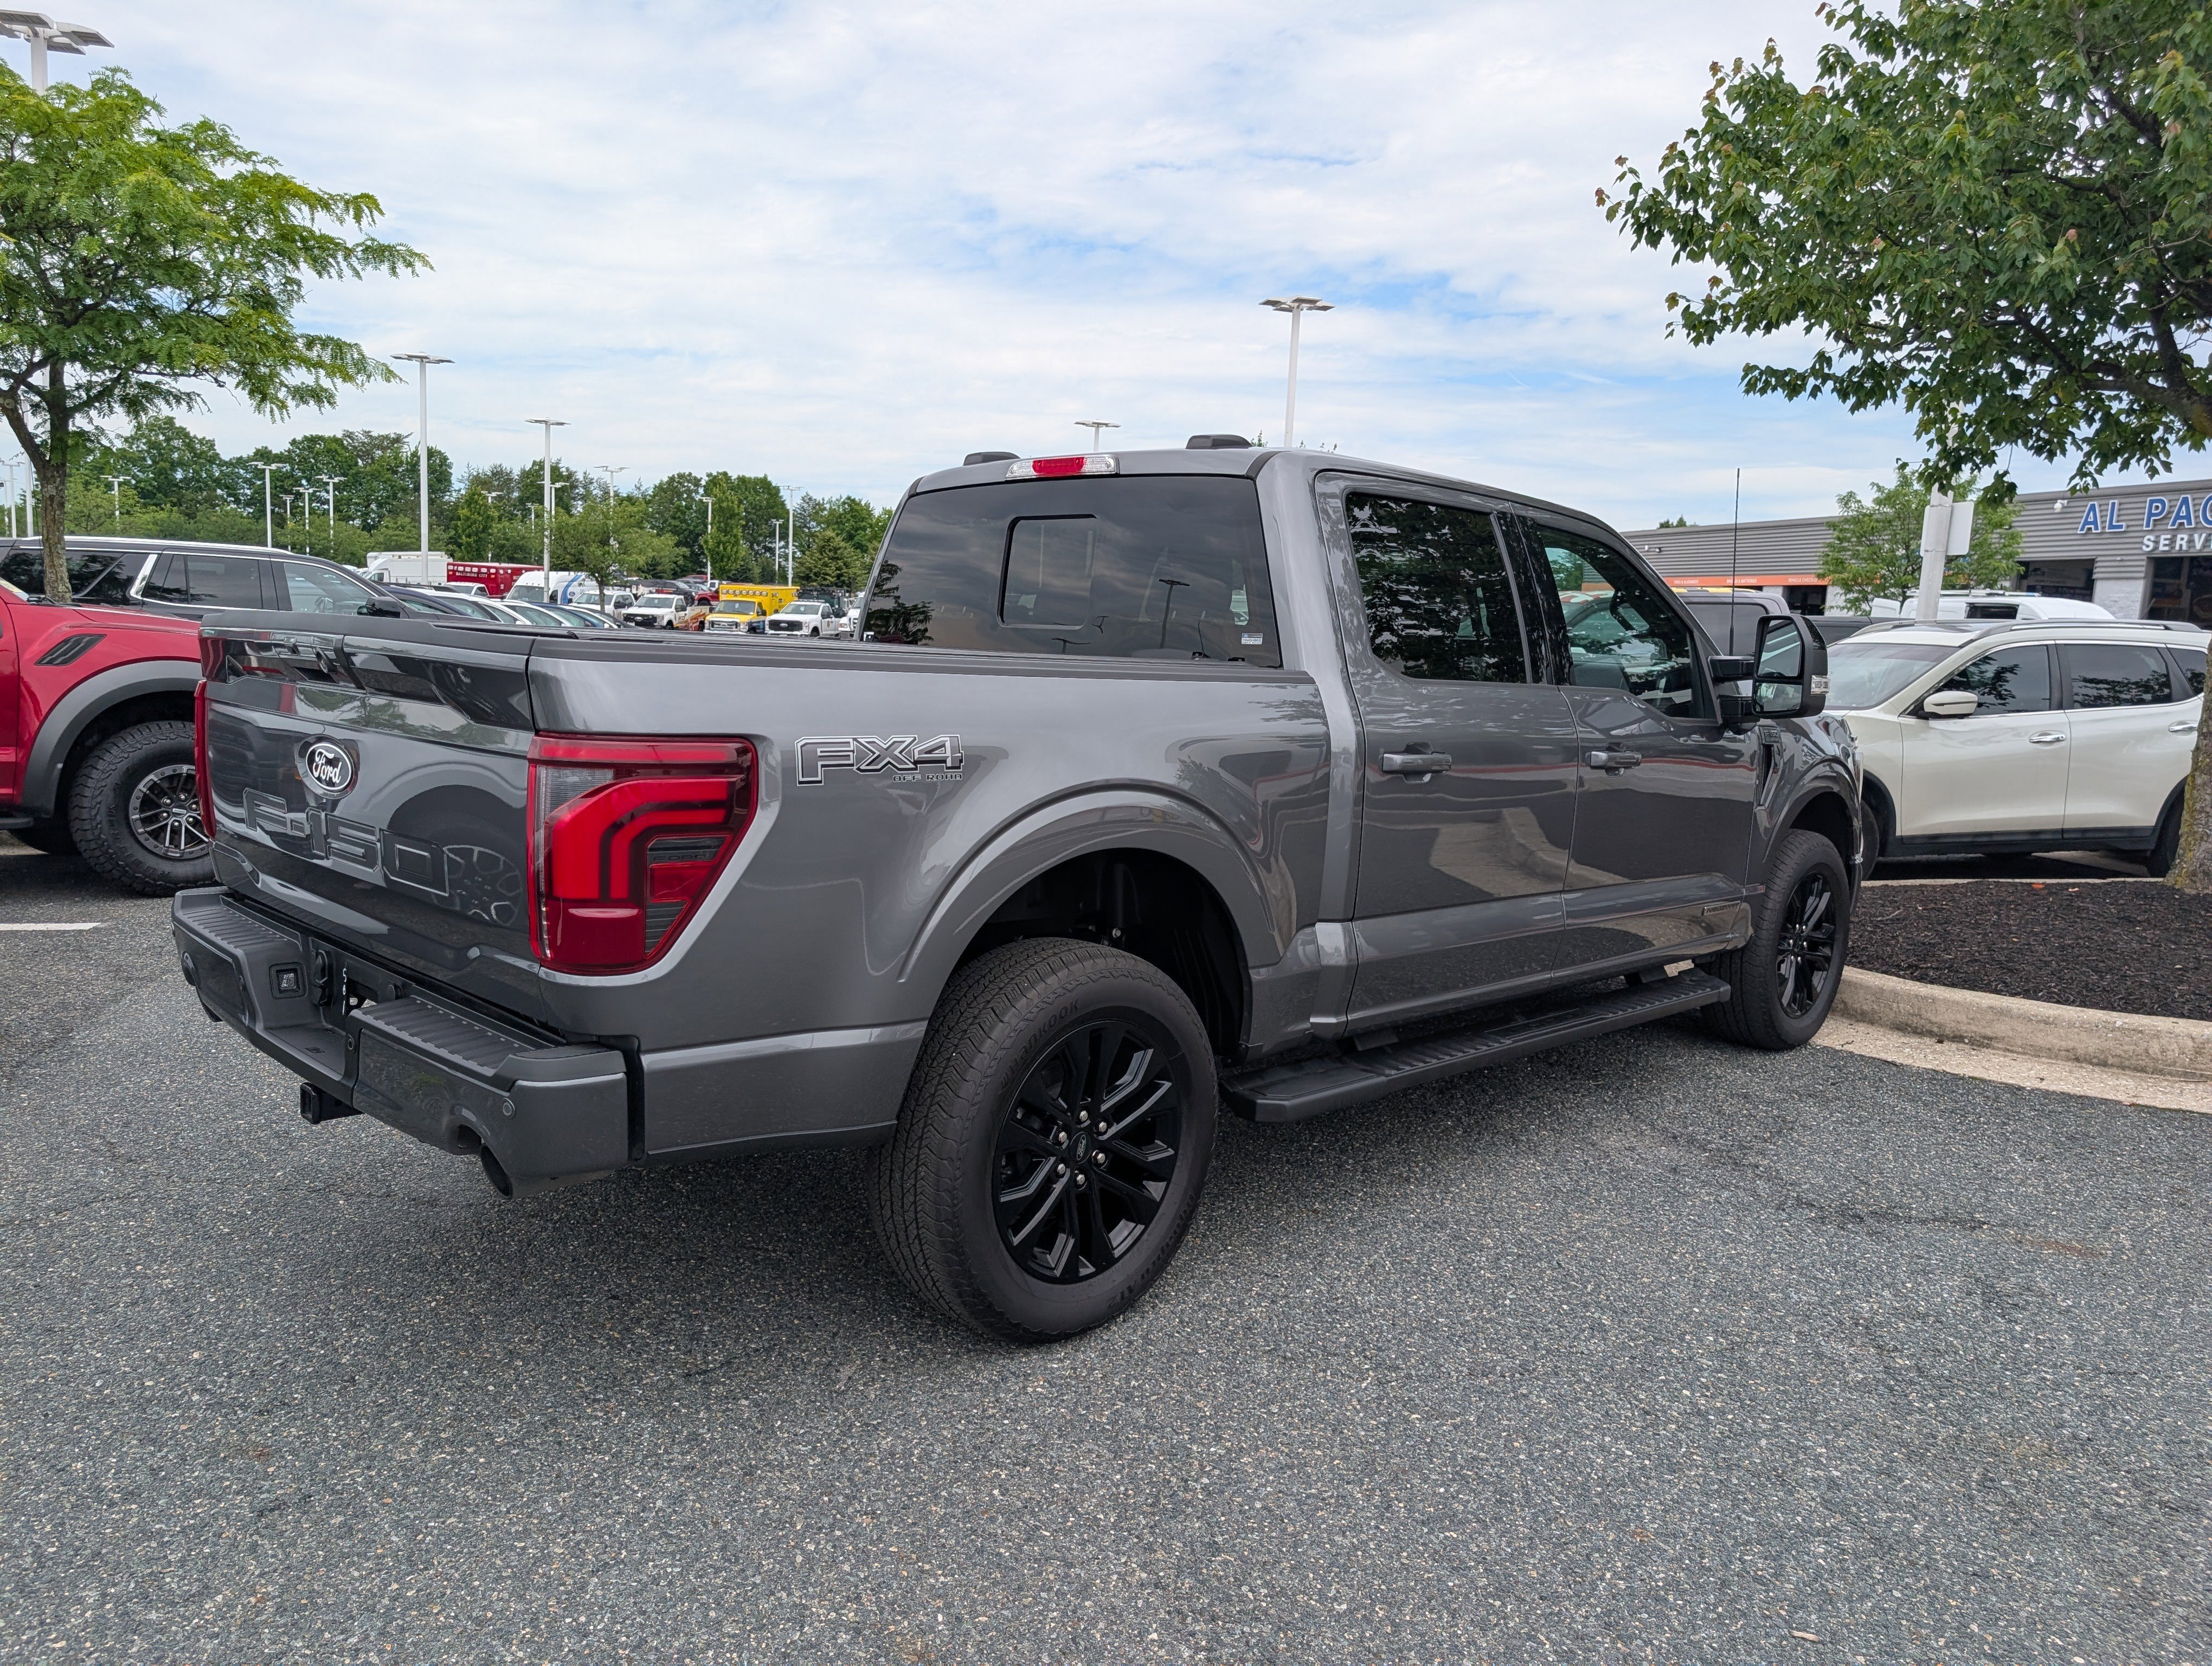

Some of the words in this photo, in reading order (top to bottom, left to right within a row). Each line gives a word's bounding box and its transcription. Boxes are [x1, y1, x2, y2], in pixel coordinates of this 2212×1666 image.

[2077, 499, 2126, 534] AL
[2142, 533, 2212, 552] SERV
[312, 748, 342, 784] Ford
[794, 734, 964, 786] FX4
[892, 774, 921, 783] OFF
[925, 773, 963, 781] ROAD
[242, 787, 449, 896] F-150
